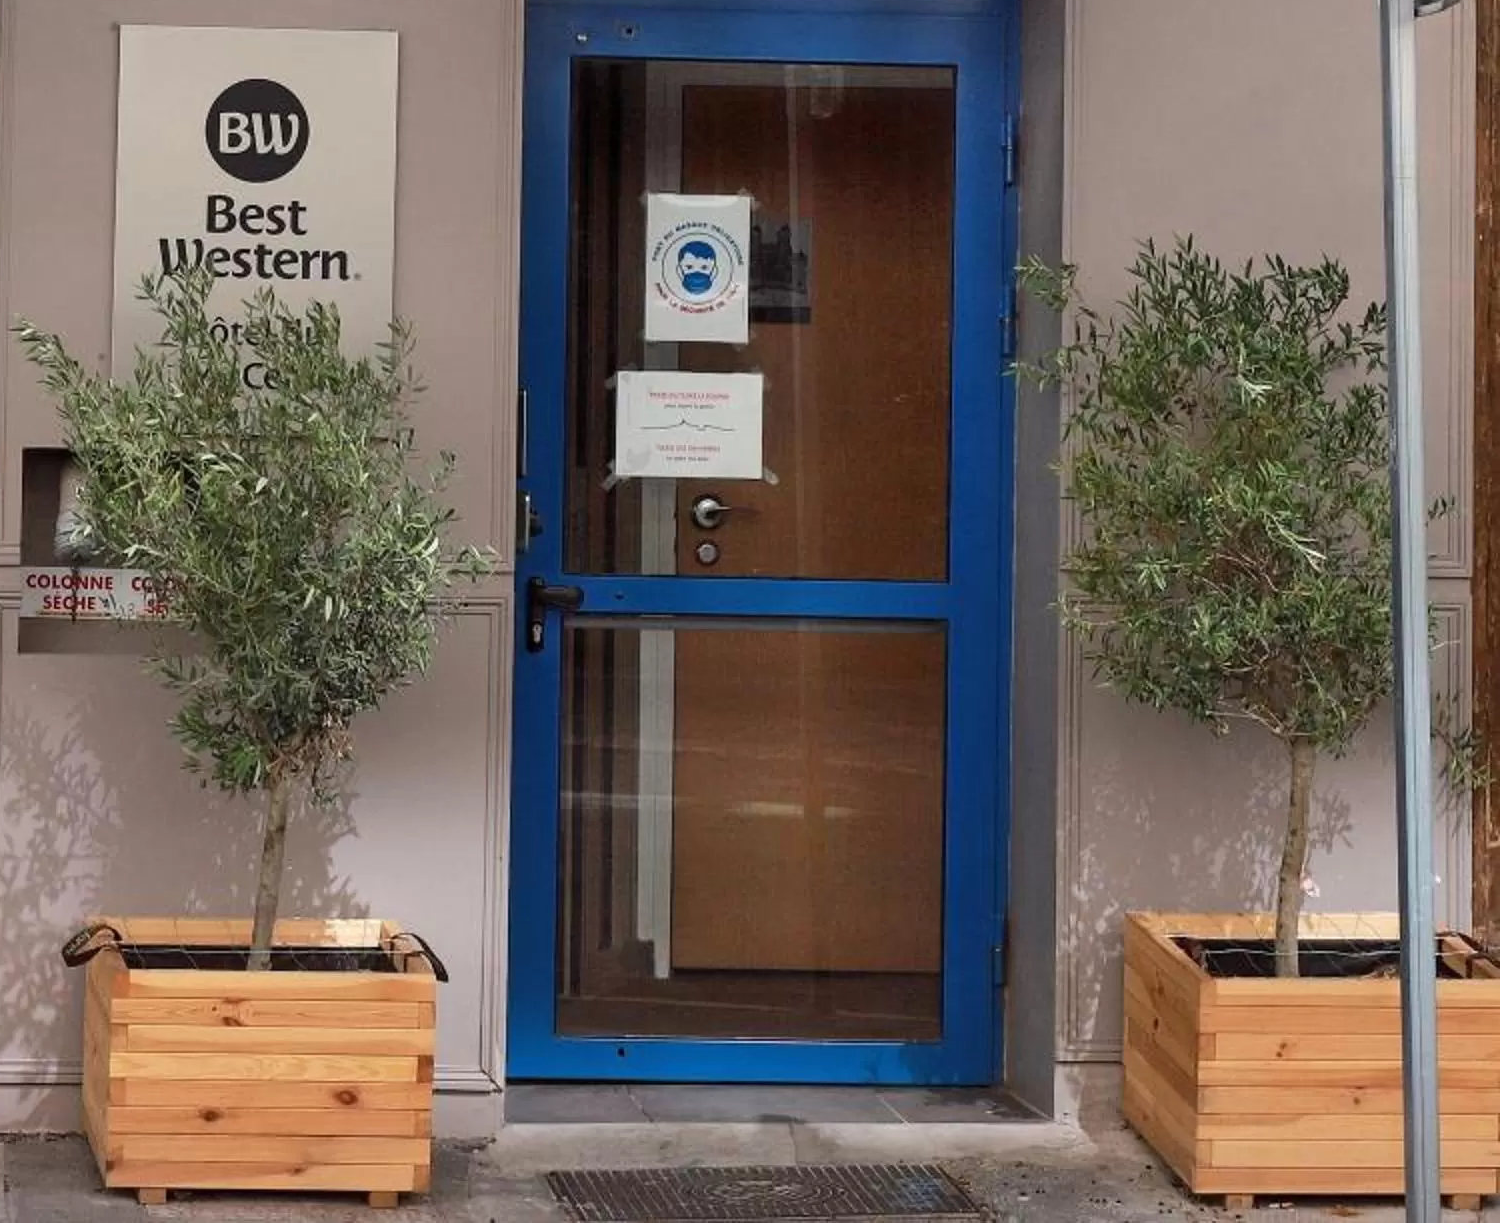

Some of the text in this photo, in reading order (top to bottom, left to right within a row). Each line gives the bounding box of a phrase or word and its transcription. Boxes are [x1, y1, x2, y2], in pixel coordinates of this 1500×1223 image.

[218, 111, 300, 157] BW
[206, 194, 307, 236] Best
[26, 574, 113, 590] COLONNE
